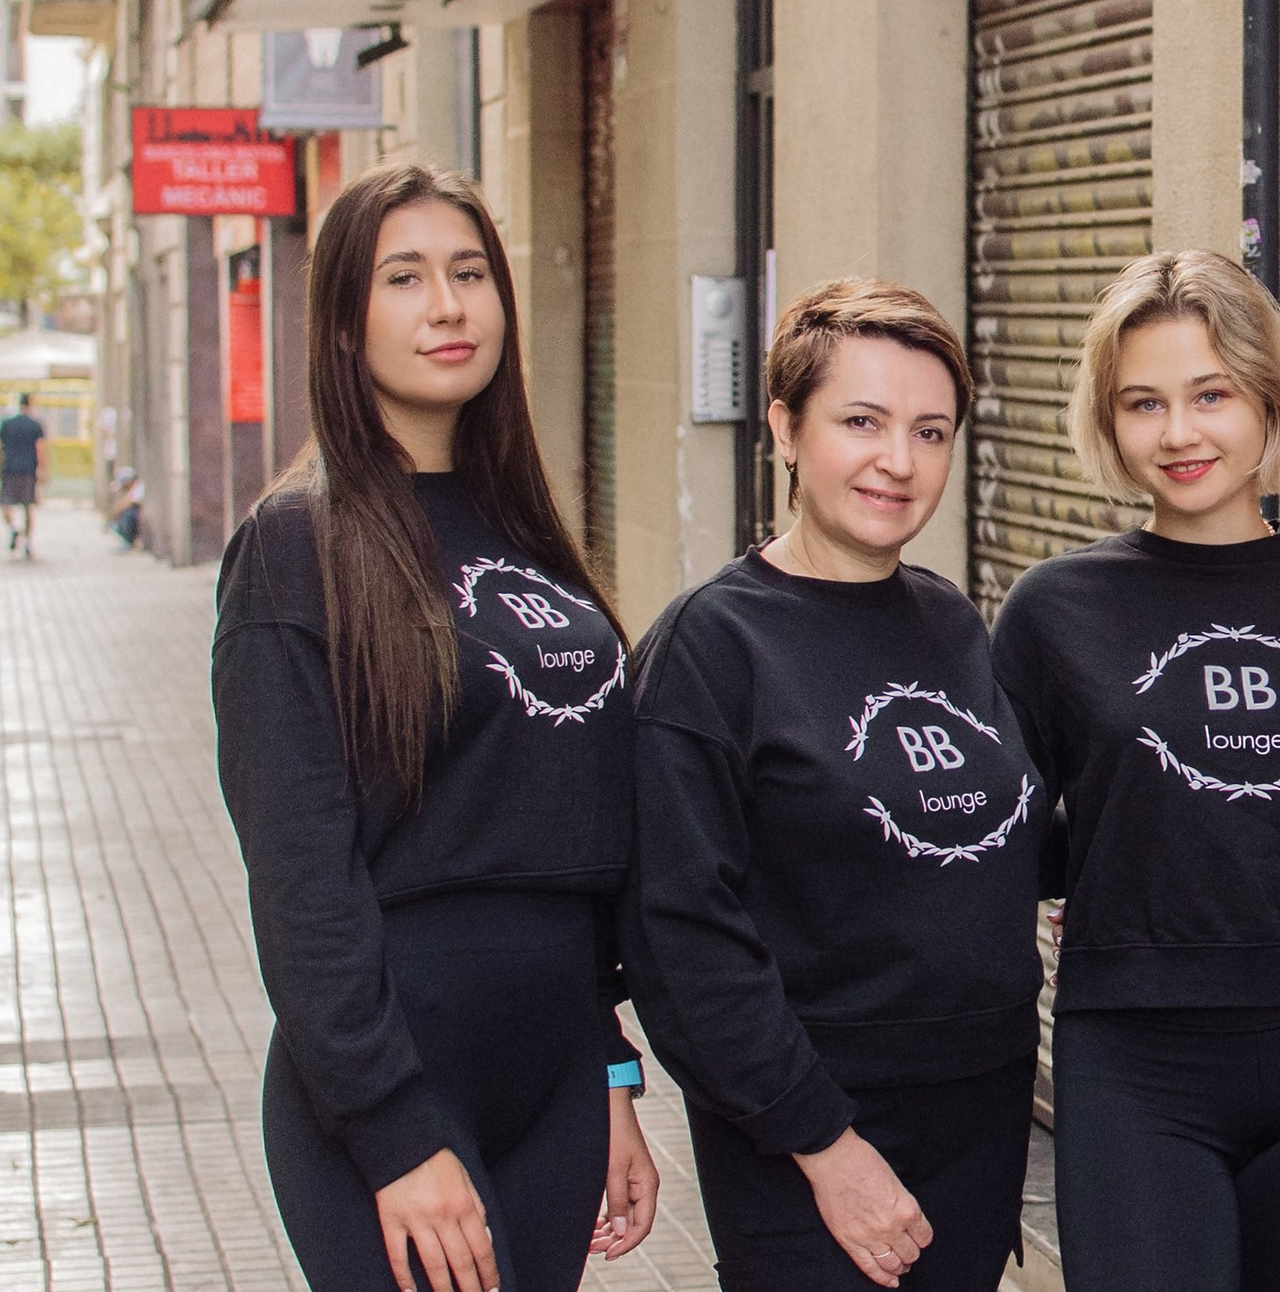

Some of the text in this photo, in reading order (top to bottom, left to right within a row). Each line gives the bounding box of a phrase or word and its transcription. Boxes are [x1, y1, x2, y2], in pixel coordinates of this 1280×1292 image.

[497, 592, 571, 629] BB
[536, 644, 596, 673] lounge
[1203, 664, 1278, 711] BB
[896, 725, 966, 773] BB
[918, 789, 988, 815] lounge
